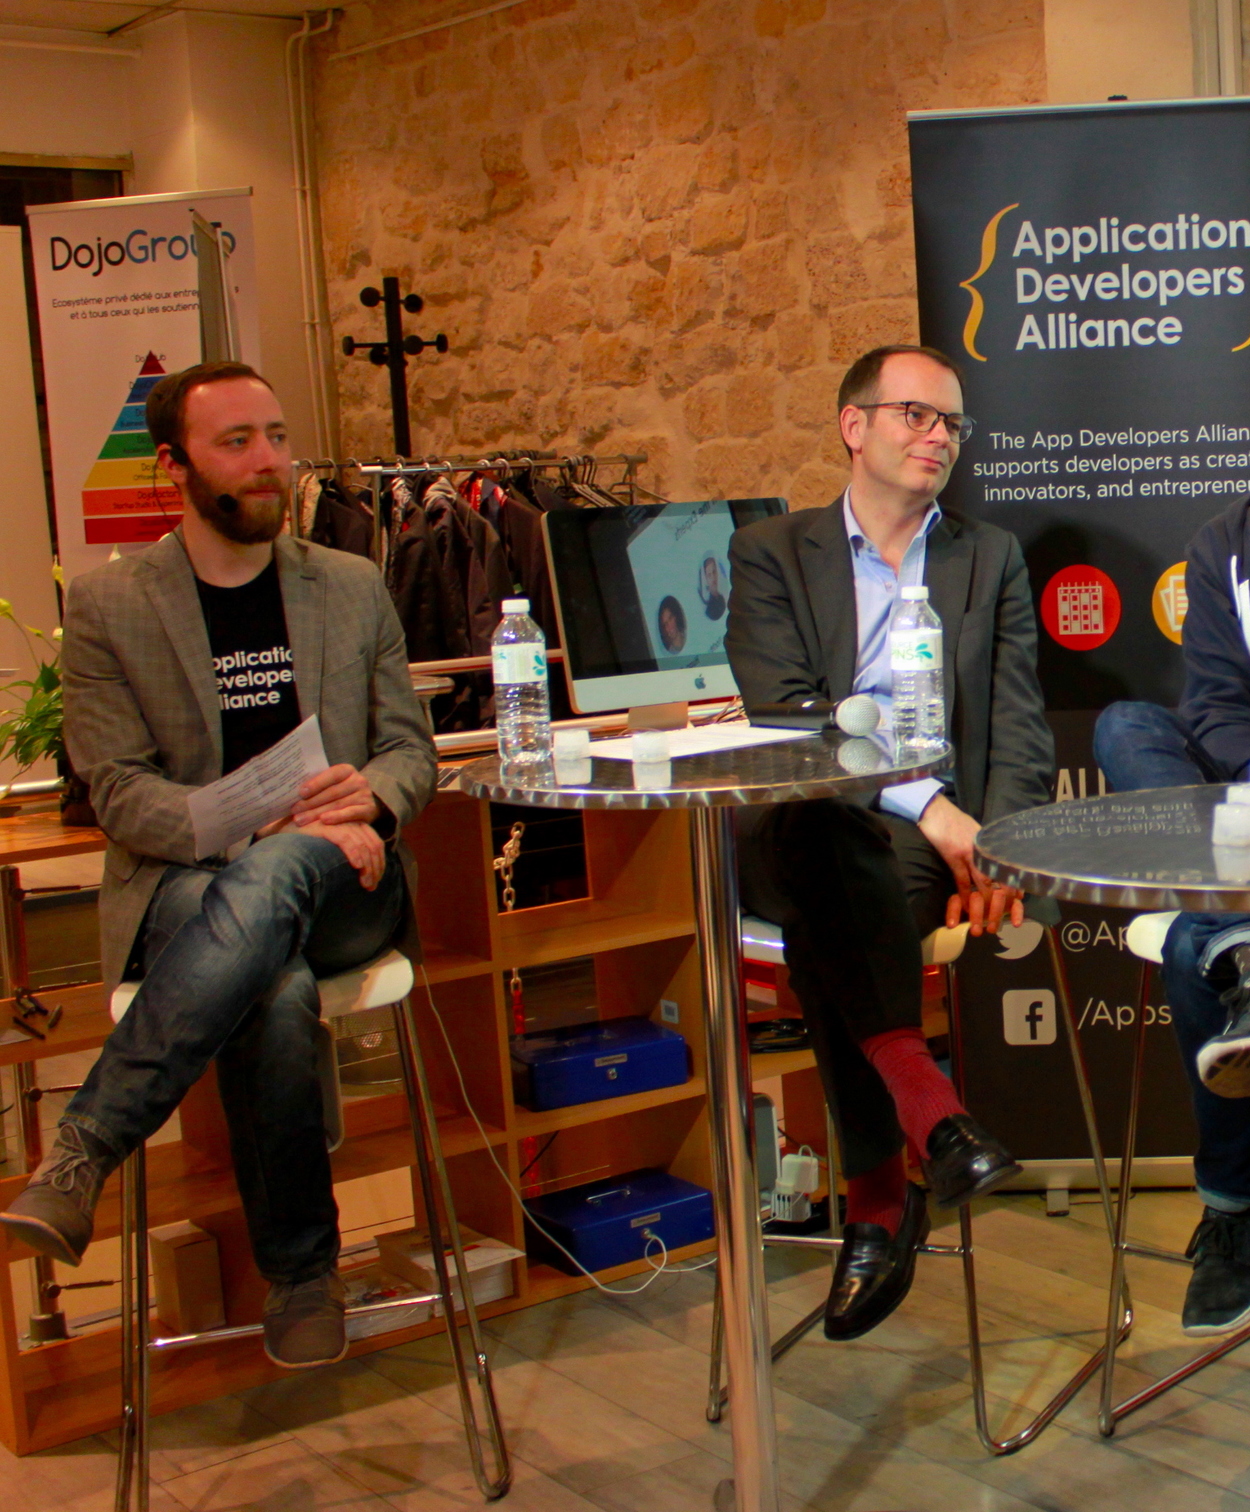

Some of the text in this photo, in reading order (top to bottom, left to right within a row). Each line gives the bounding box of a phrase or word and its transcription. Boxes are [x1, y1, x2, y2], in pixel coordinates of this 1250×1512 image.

[1016, 263, 1246, 307] Developers
[1015, 312, 1183, 351] Alliance
[990, 432, 1026, 450] The
[1031, 430, 1073, 451] App
[1079, 427, 1190, 448] Developers
[973, 457, 1059, 479] supports
[1065, 454, 1173, 474] developers
[1178, 454, 1200, 469] as
[984, 482, 1091, 502] innovators,
[1096, 479, 1133, 498] and
